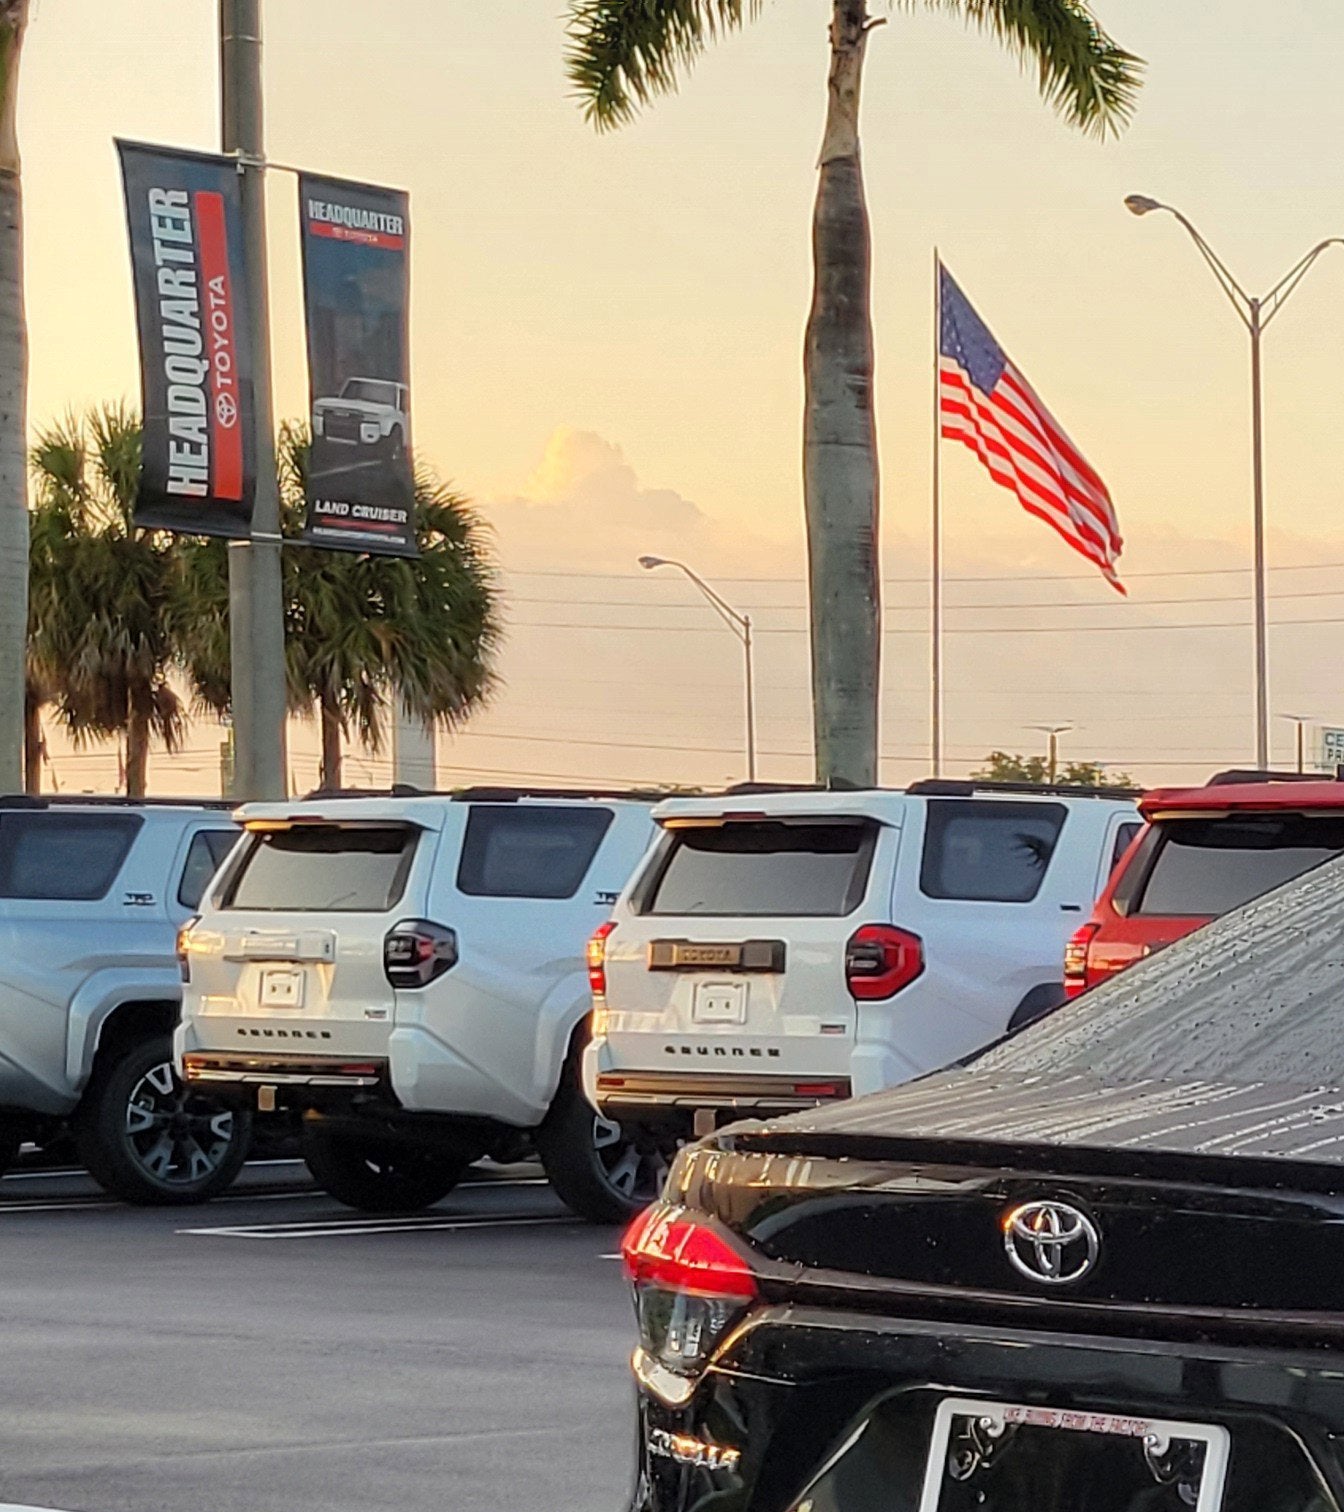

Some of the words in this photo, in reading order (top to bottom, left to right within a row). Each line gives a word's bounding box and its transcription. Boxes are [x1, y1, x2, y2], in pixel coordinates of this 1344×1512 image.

[307, 198, 404, 236] HEADQUARTER
[148, 187, 209, 498] HEADQUARTER
[208, 275, 236, 388] TOYOTA
[314, 499, 350, 516] LAND
[351, 504, 408, 524] CRUISER
